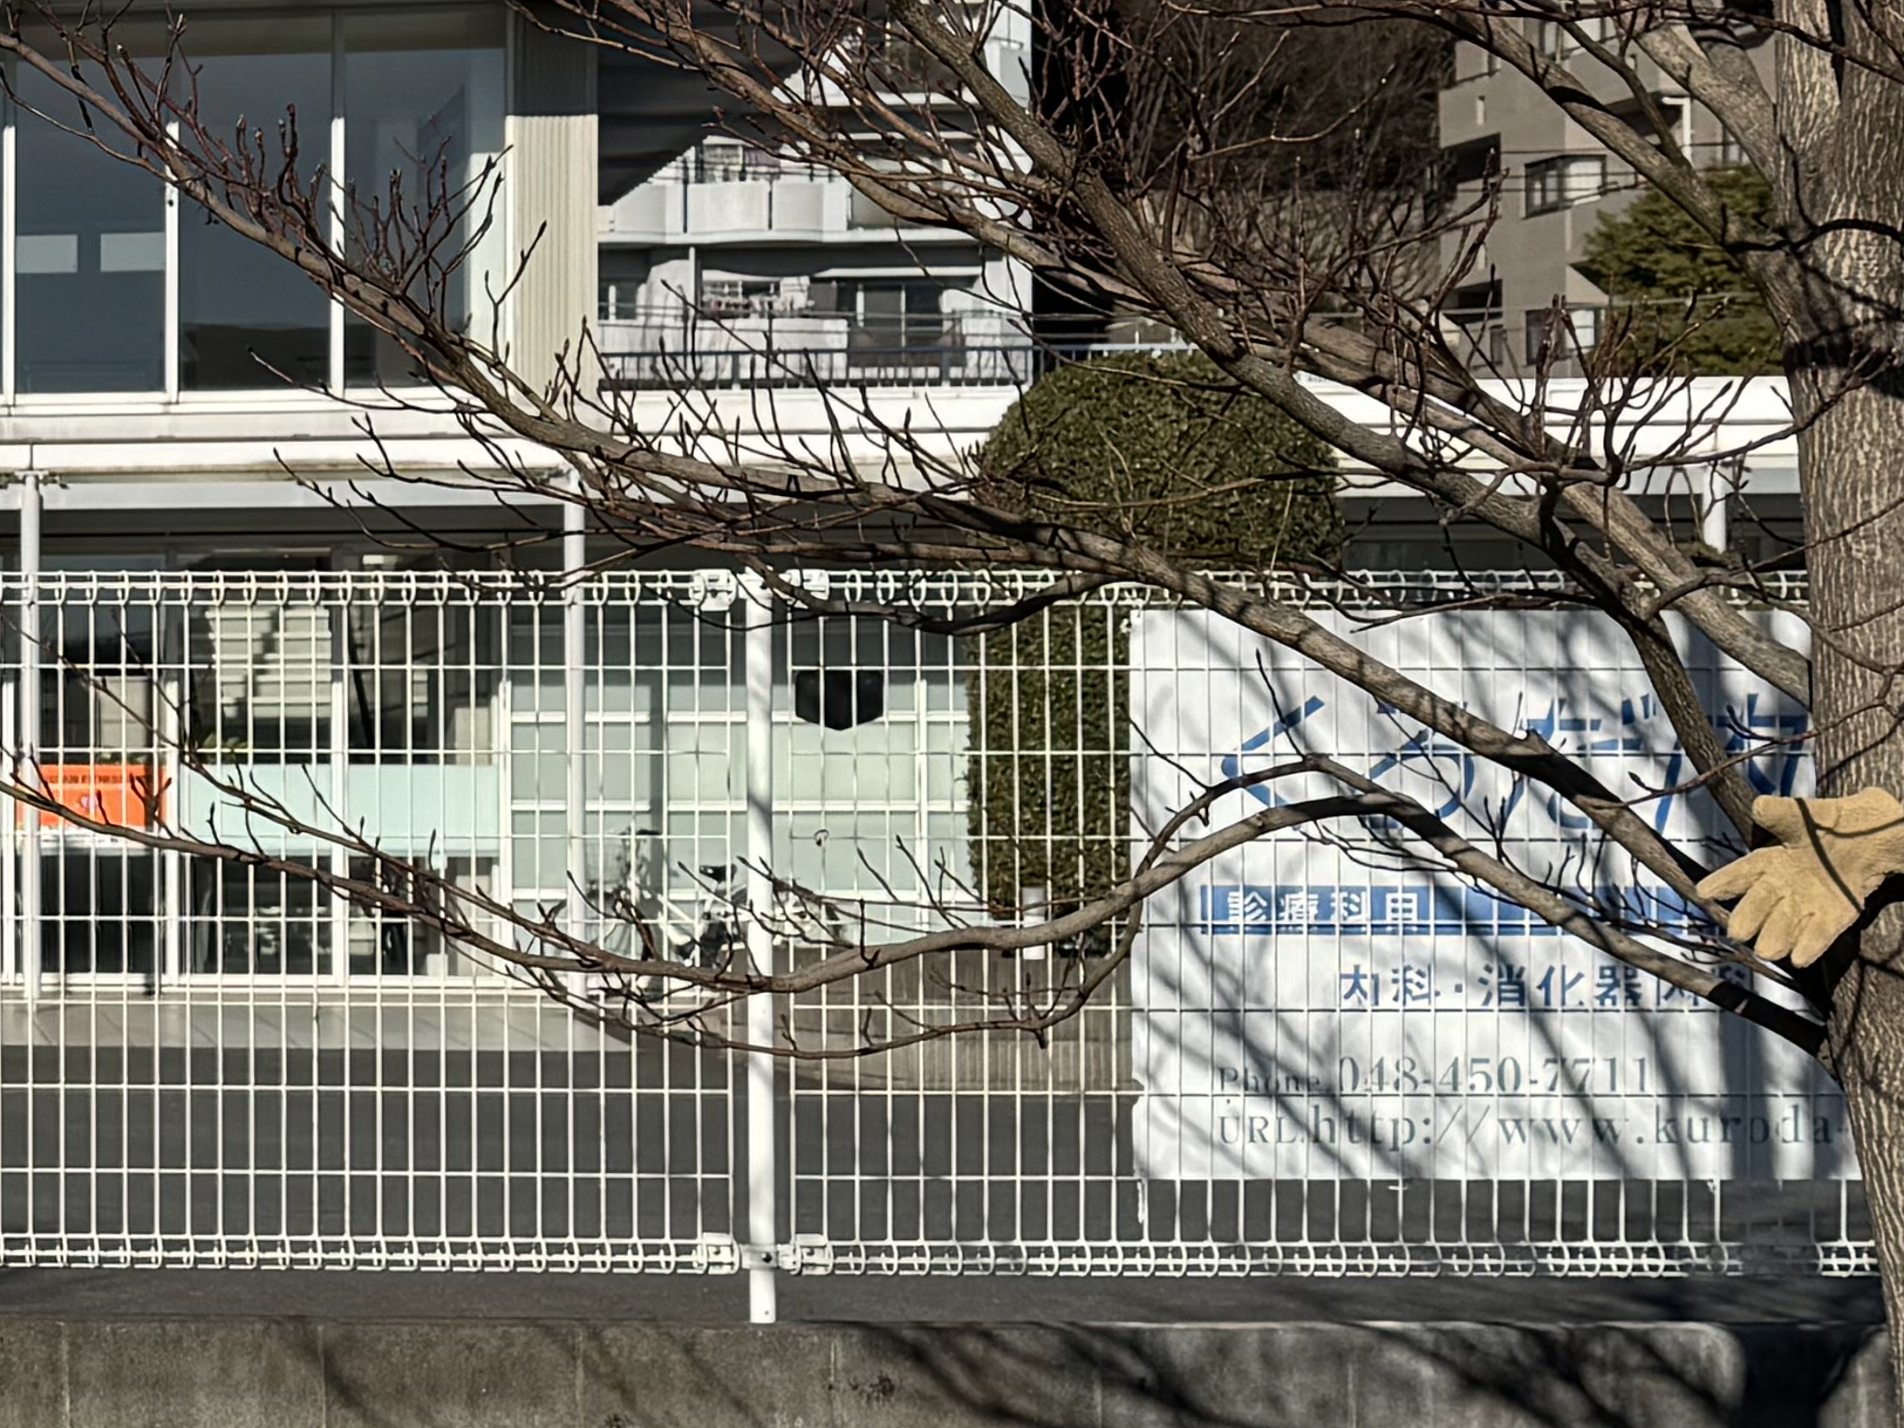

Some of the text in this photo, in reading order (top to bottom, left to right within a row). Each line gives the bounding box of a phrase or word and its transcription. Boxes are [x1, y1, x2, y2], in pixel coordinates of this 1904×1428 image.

[1227, 891, 1420, 932] 診療科目
[1339, 1056, 1649, 1093] 048-450-7711
